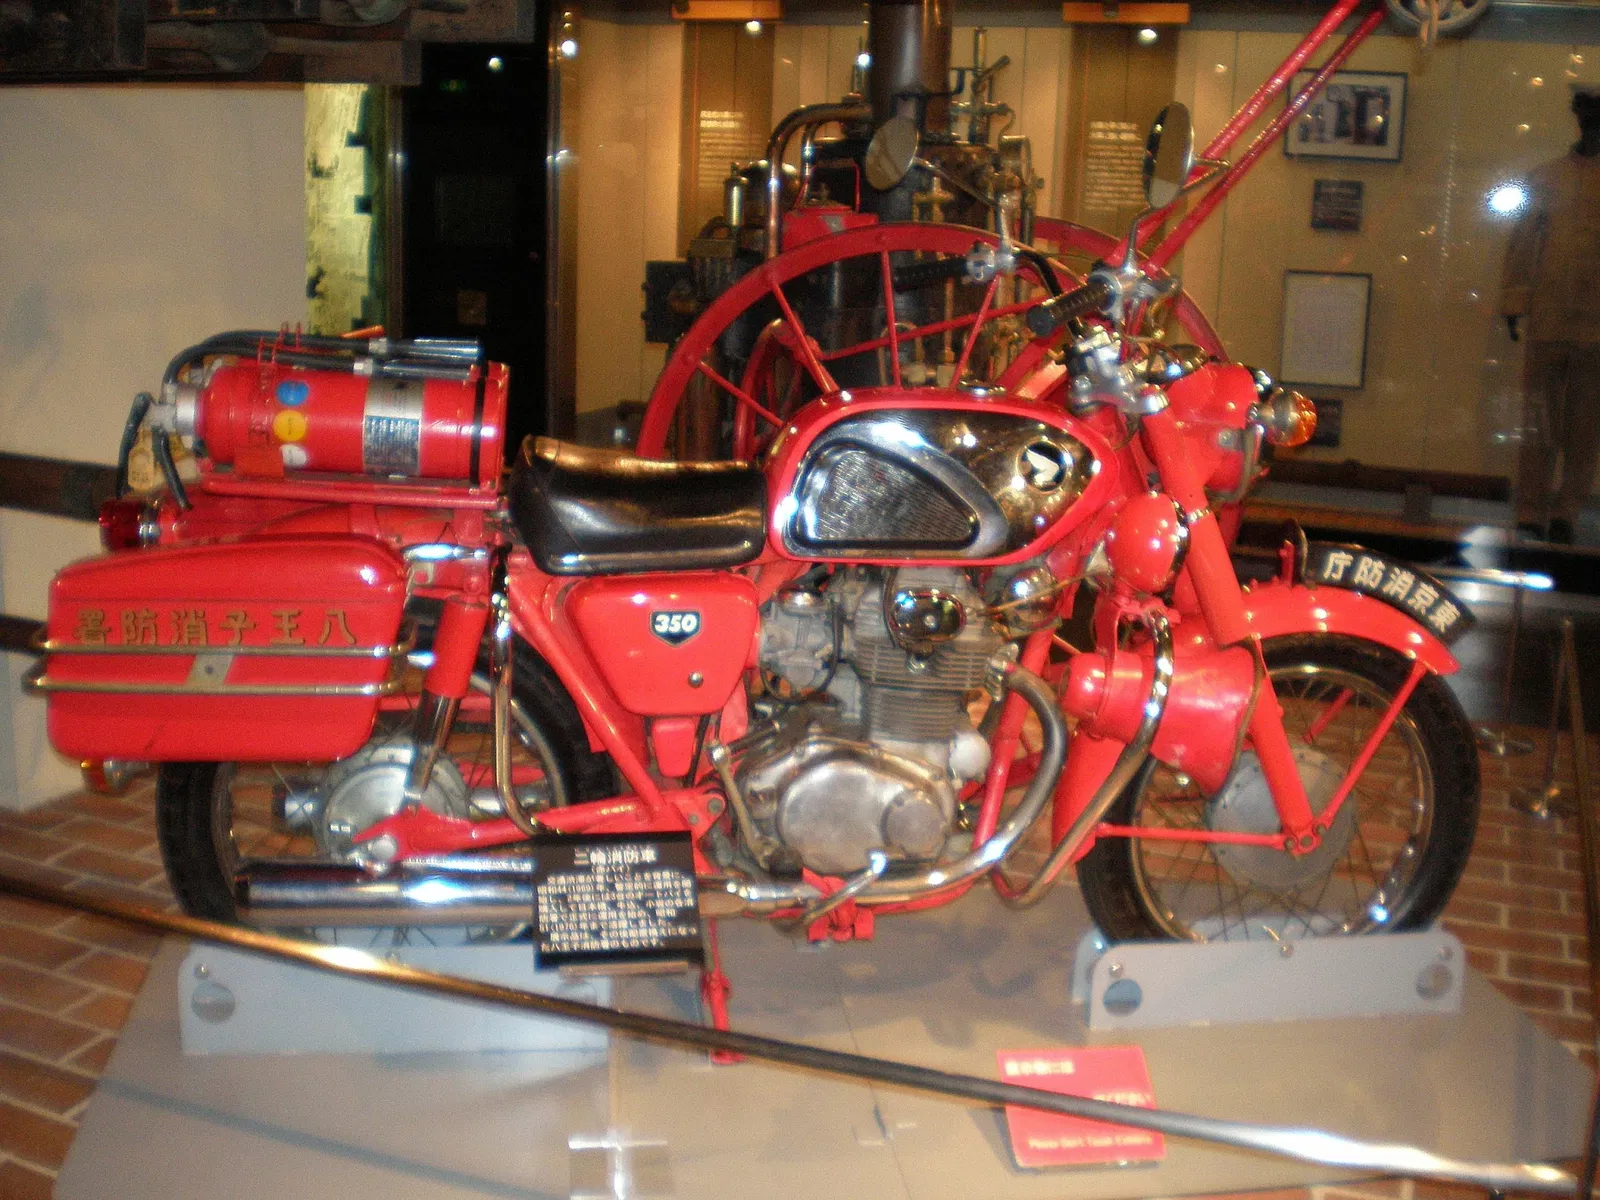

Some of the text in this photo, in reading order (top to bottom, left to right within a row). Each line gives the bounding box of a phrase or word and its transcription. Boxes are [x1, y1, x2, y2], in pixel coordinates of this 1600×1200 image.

[655, 614, 697, 632] 350
[574, 850, 658, 865] 二輪消防車
